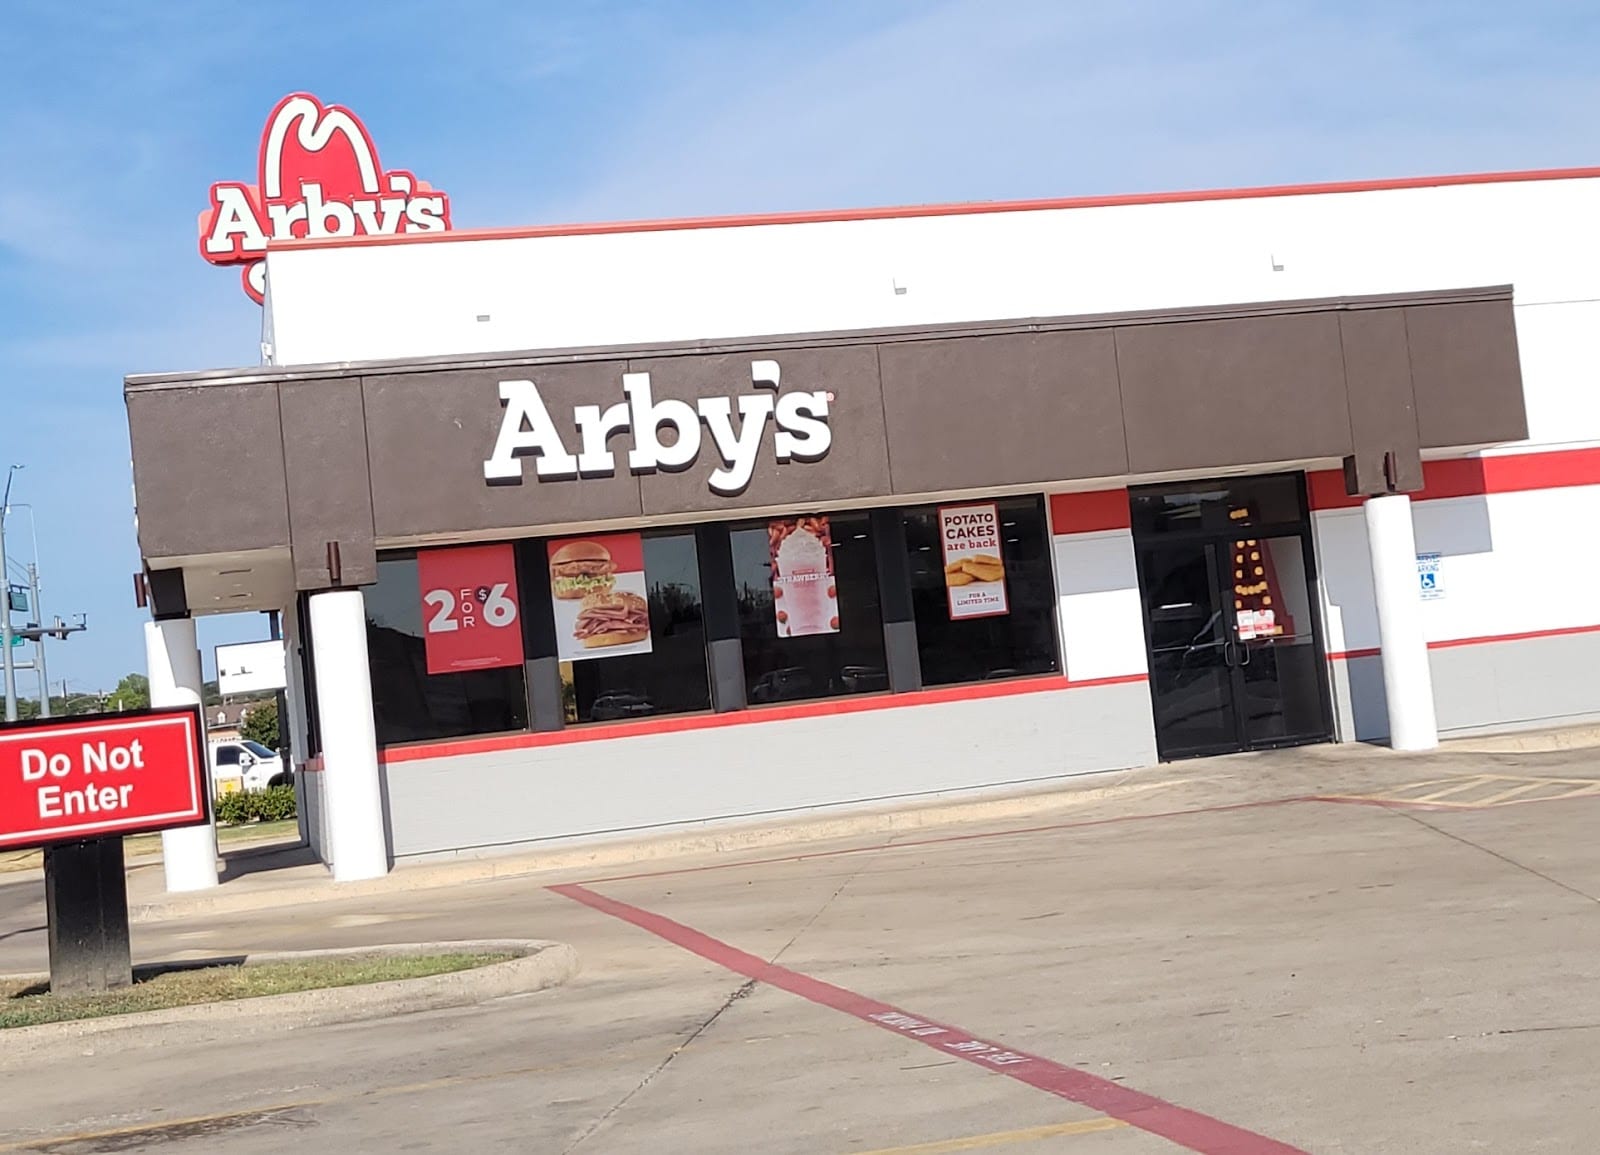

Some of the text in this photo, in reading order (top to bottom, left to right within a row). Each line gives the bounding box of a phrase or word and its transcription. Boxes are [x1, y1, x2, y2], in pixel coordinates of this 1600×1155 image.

[484, 360, 832, 491] Arby's
[944, 513, 994, 527] POTATO
[946, 525, 995, 540] CAKES
[947, 538, 997, 551] are back
[423, 588, 459, 633] 2
[460, 588, 475, 628] FOR
[957, 598, 983, 606] LIMITED
[21, 738, 144, 781] Do Not
[38, 782, 133, 819] Enter
